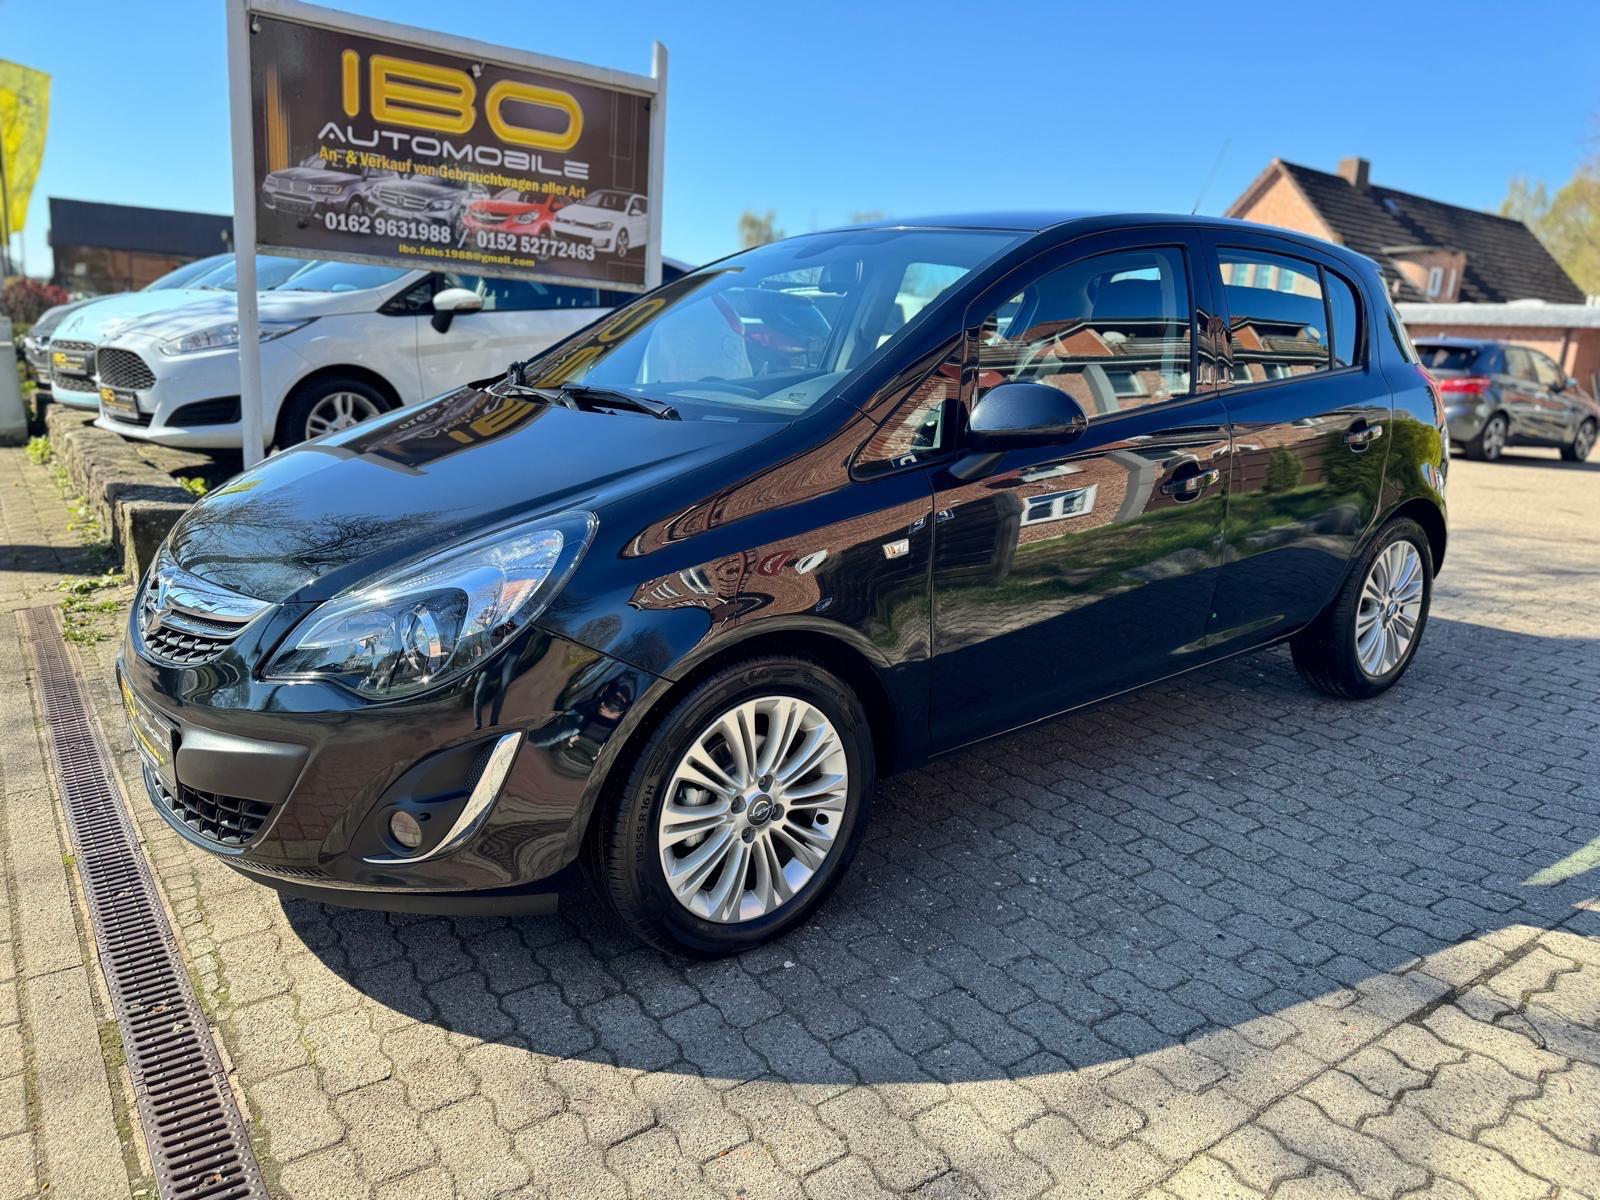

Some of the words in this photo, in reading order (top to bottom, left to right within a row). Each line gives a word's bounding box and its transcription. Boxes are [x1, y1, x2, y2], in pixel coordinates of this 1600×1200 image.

[341, 48, 584, 153] IBO
[318, 122, 590, 180] AUTOMOBILE
[319, 145, 342, 162] An-
[345, 150, 357, 165] &
[360, 152, 411, 172] Verkauf
[413, 164, 436, 176] von
[439, 164, 539, 192] Gebrauchtwagen
[541, 182, 567, 196] aller
[568, 185, 586, 199] Art
[325, 212, 371, 234] 0162
[374, 217, 451, 243] 9631988
[457, 228, 469, 248] /
[476, 230, 517, 251] 0152
[520, 235, 595, 261] 52772463
[645, 785, 654, 794] H
